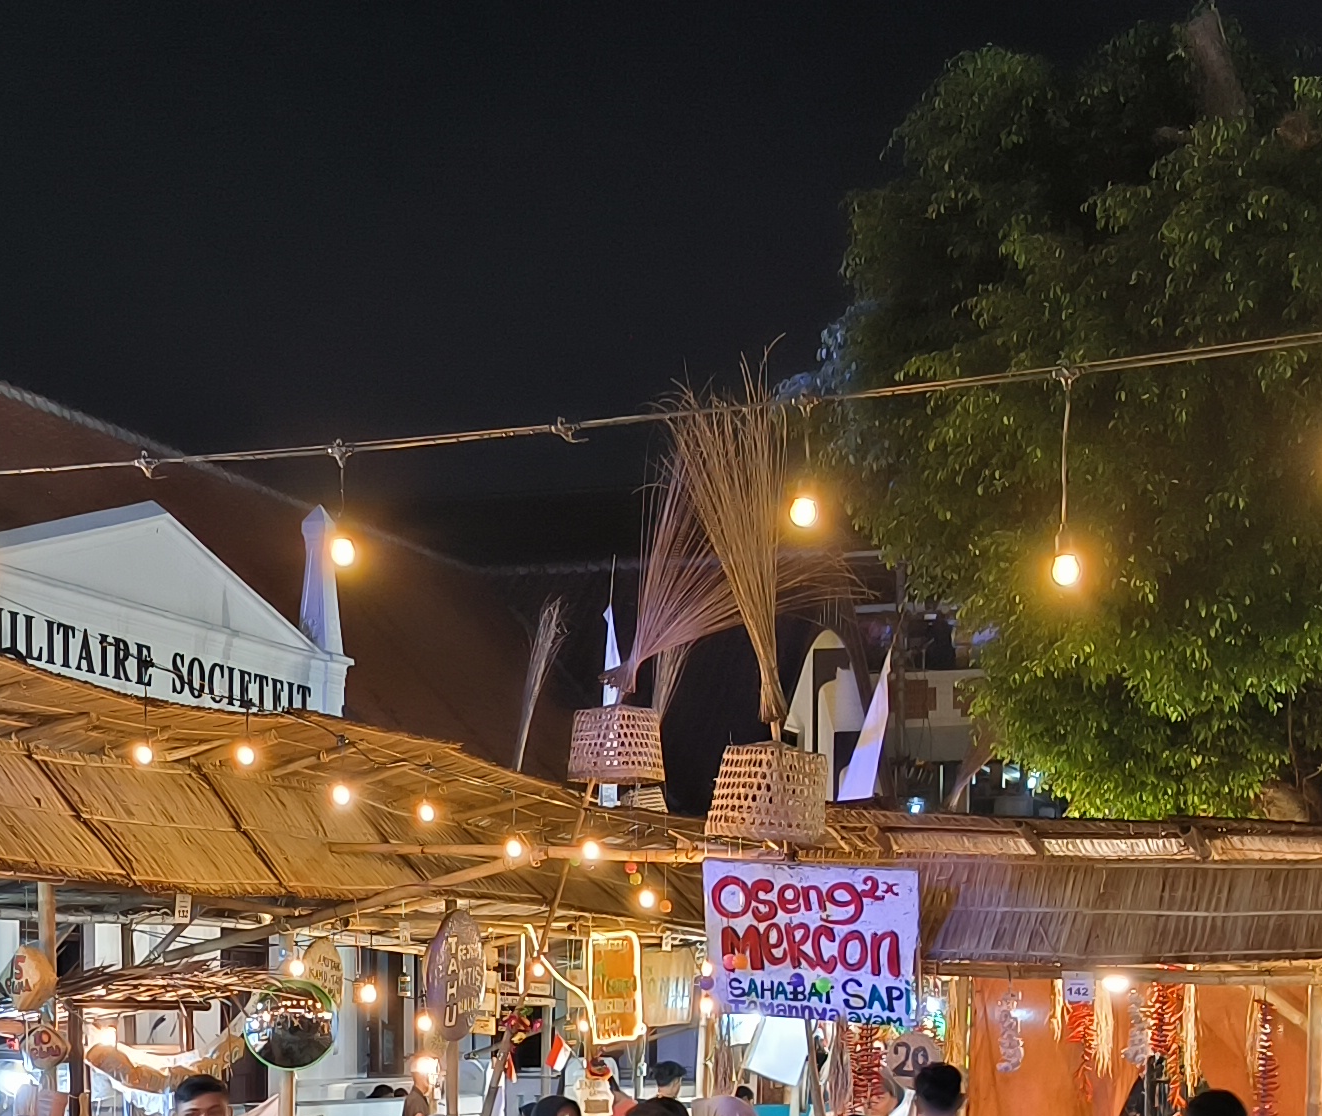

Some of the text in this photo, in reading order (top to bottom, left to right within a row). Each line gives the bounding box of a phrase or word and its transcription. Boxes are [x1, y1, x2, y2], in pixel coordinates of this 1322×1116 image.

[170, 652, 313, 714] SOCIETEIT
[711, 875, 864, 926] Oseng
[444, 936, 460, 1027] TAHU
[1066, 986, 1089, 997] 142
